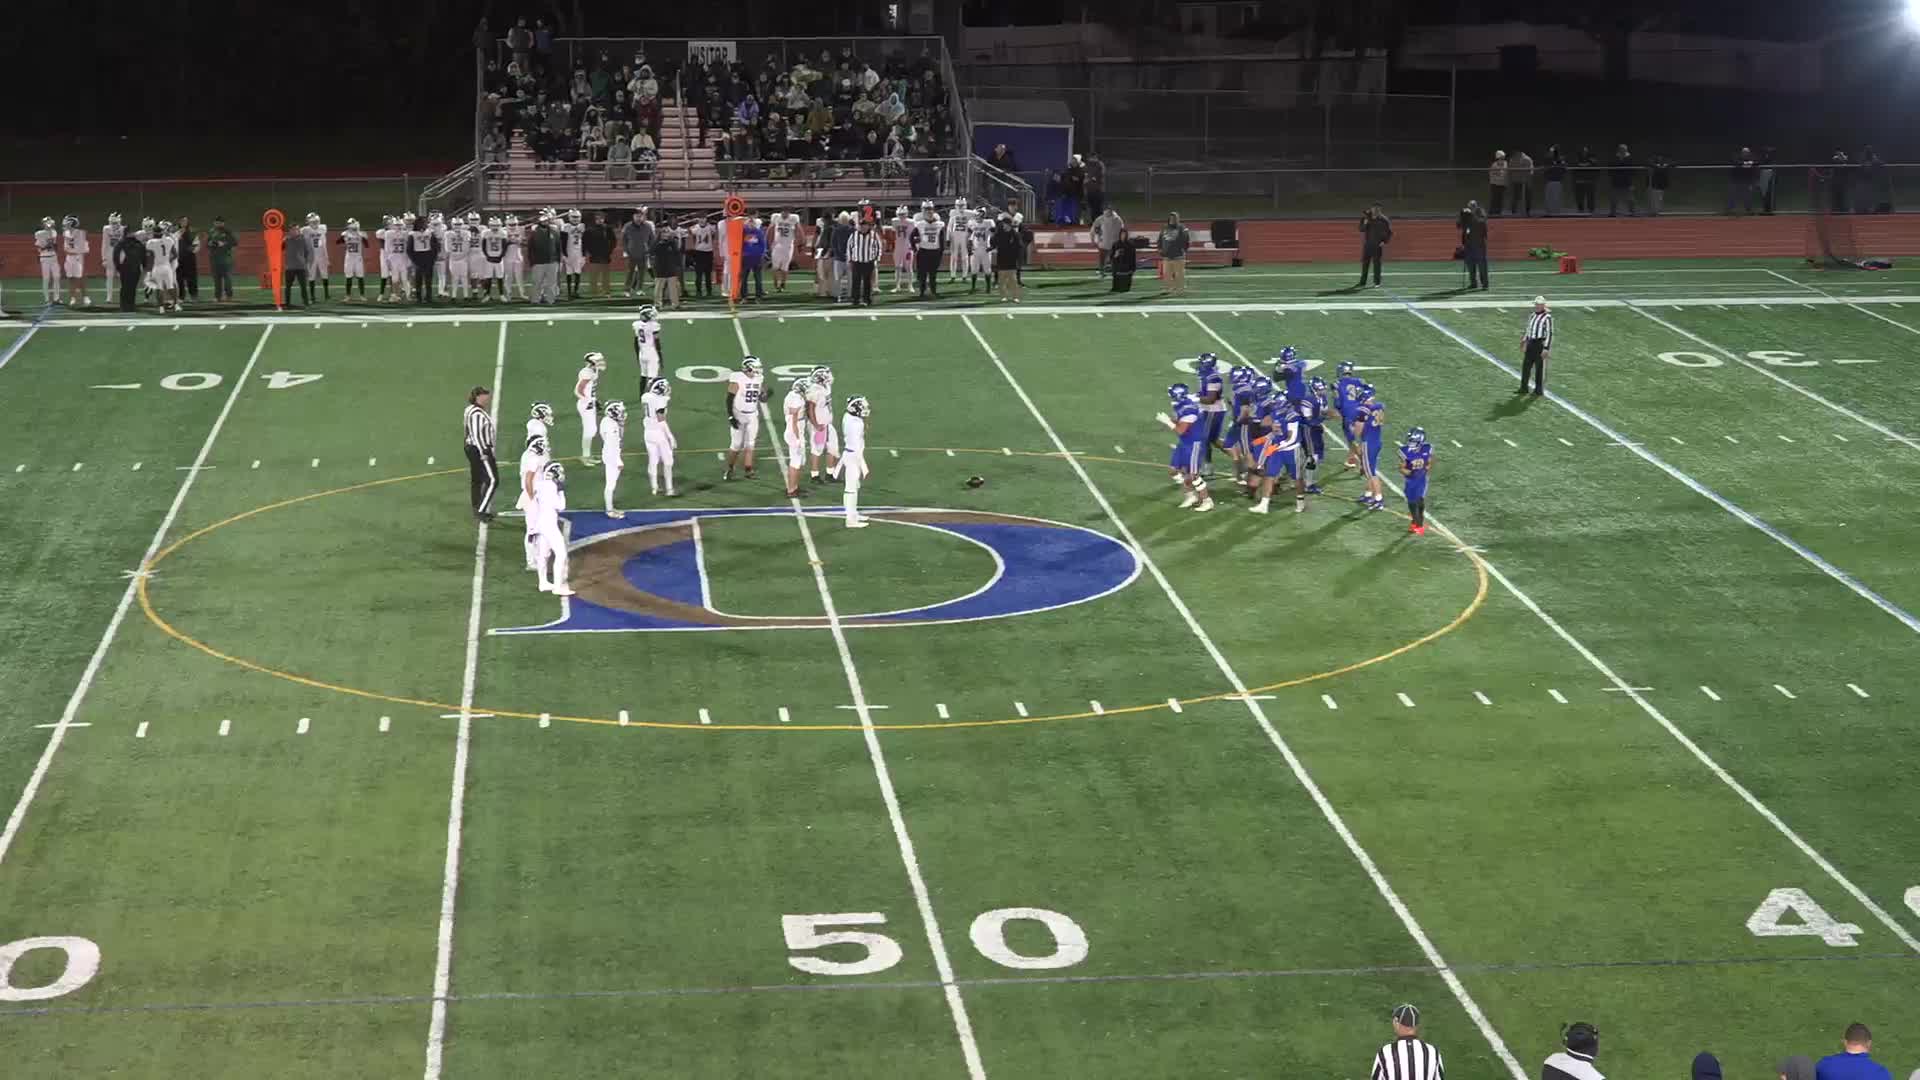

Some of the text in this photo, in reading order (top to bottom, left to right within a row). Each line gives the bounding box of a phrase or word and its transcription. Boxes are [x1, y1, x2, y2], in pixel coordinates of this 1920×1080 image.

[864, 206, 874, 222] 2
[160, 244, 167, 257] 1
[638, 329, 646, 344] 9
